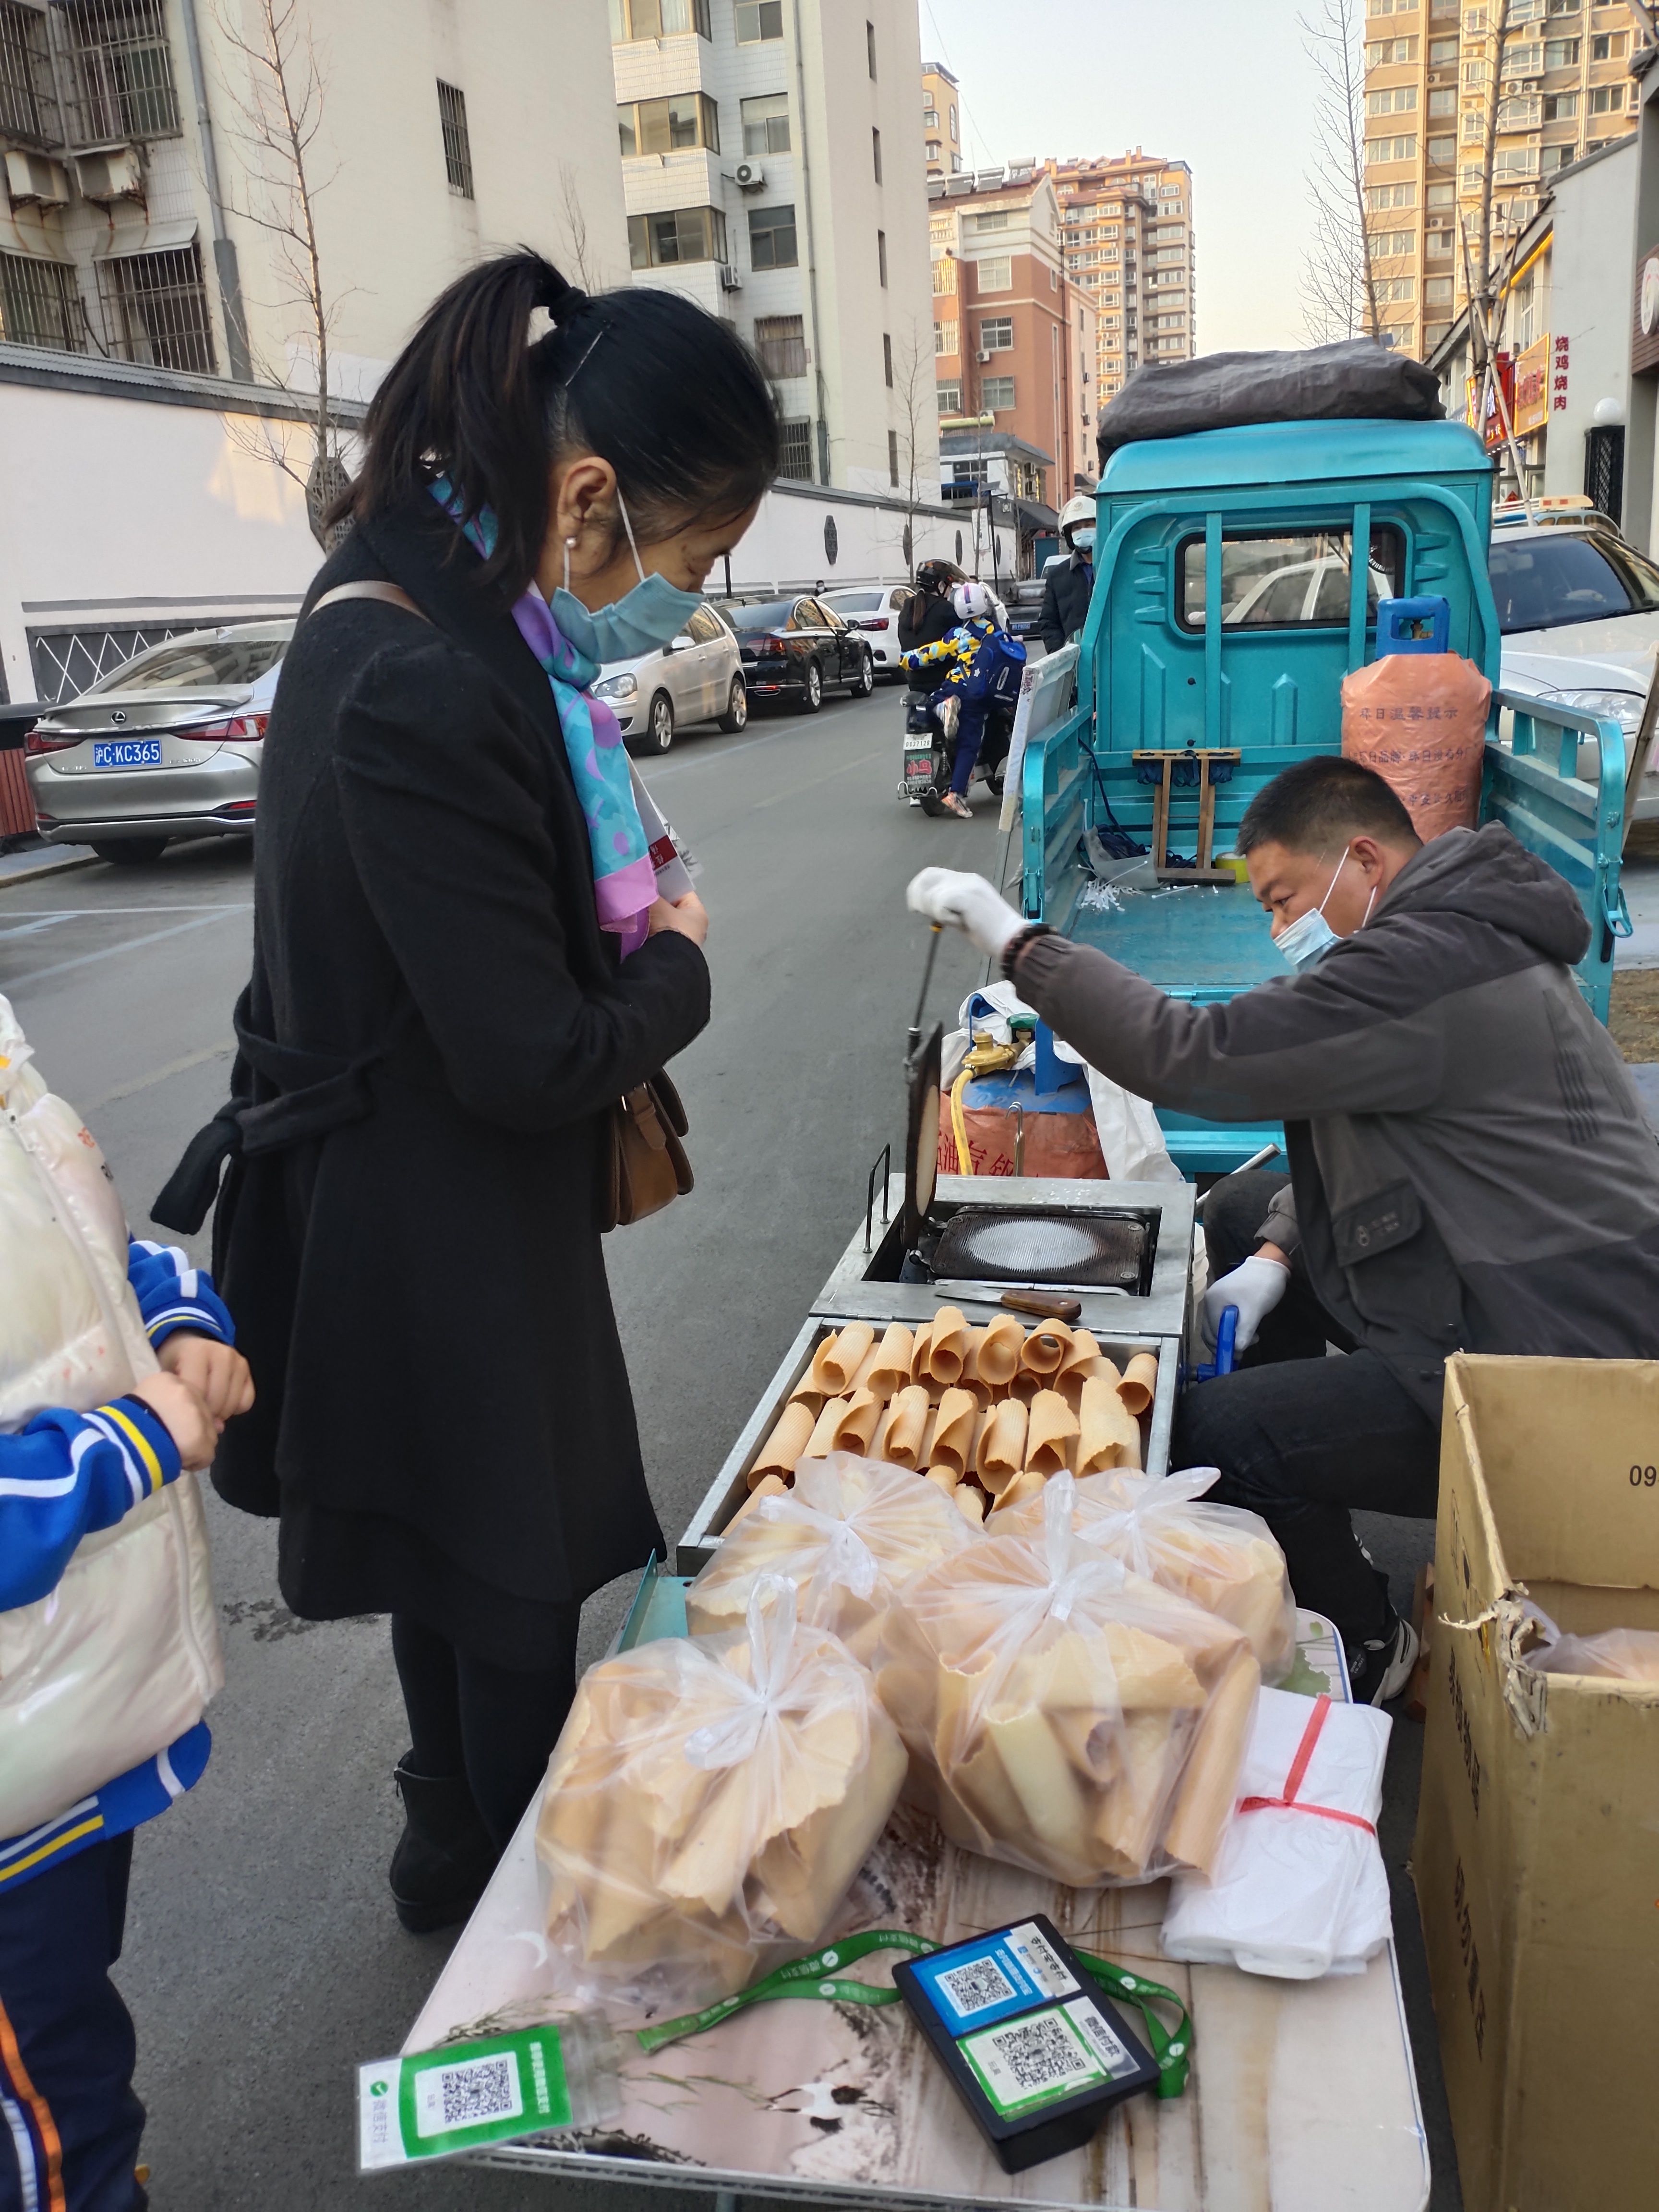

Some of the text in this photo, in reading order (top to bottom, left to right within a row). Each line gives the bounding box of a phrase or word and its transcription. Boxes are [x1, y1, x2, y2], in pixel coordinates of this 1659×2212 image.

[1554, 337, 1569, 411] 烧鸡烧肉
[1031, 1936, 1068, 1981] 支付宝支付
[1084, 2016, 1120, 2057] 微信付款
